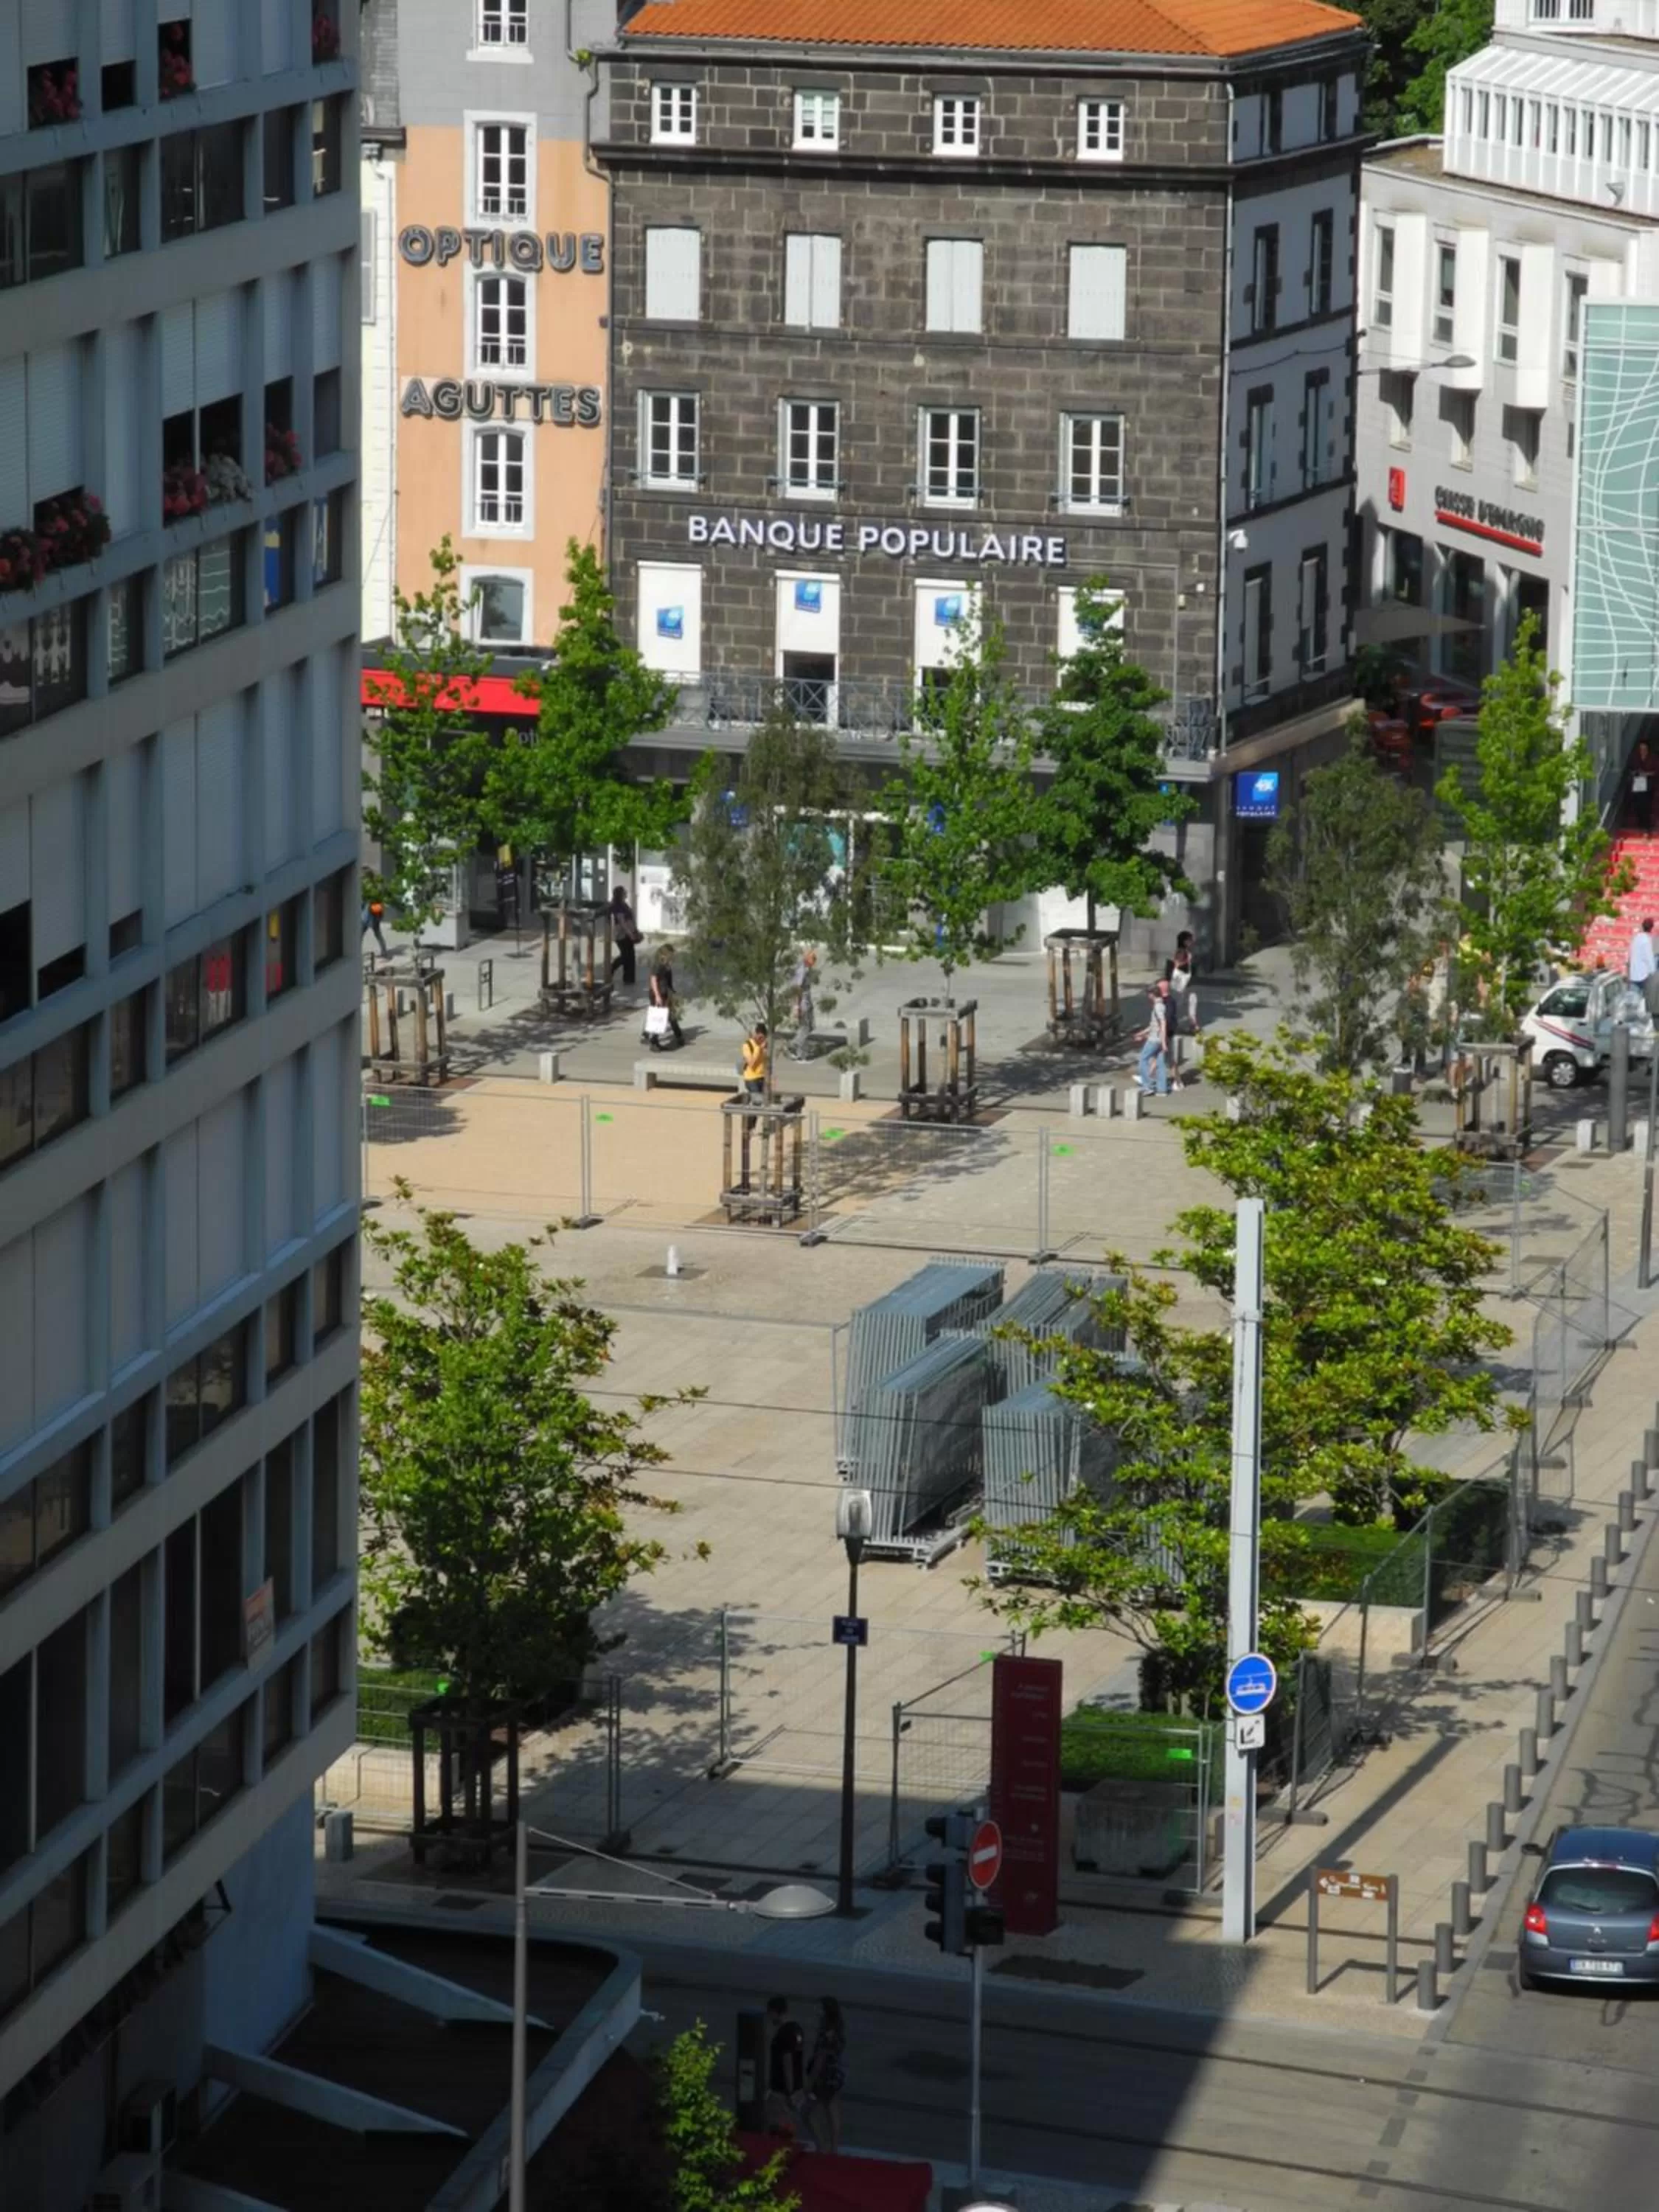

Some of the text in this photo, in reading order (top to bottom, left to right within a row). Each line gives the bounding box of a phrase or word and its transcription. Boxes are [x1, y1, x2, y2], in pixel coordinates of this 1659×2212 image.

[399, 224, 605, 274] OPTIQUE
[401, 377, 602, 428] AGUTTES
[687, 514, 1068, 566] BANQUE POPULAIRE
